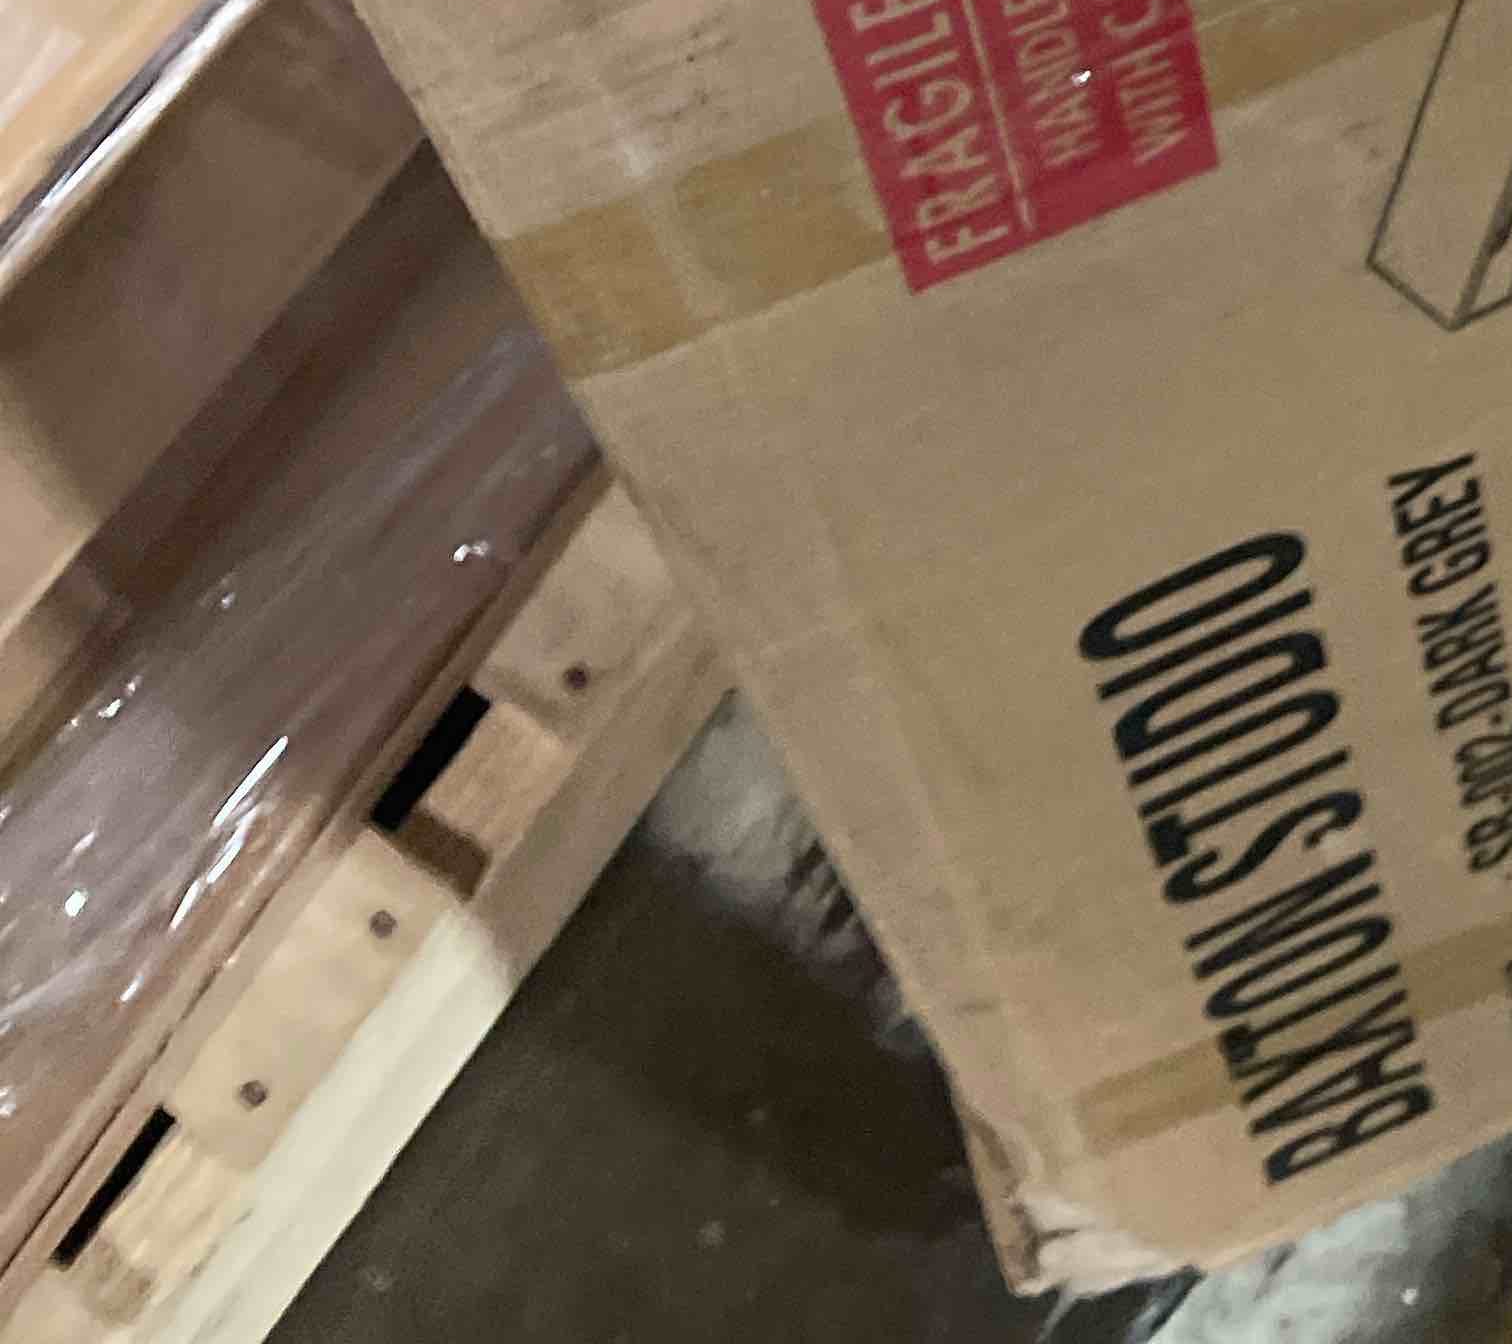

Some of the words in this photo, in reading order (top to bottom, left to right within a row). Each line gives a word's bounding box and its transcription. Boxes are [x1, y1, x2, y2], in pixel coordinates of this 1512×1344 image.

[1105, 38, 1190, 167] WITH
[1386, 450, 1492, 602] GREY
[1077, 529, 1364, 905] STUDIO
[1184, 849, 1435, 1186] BAXTON
